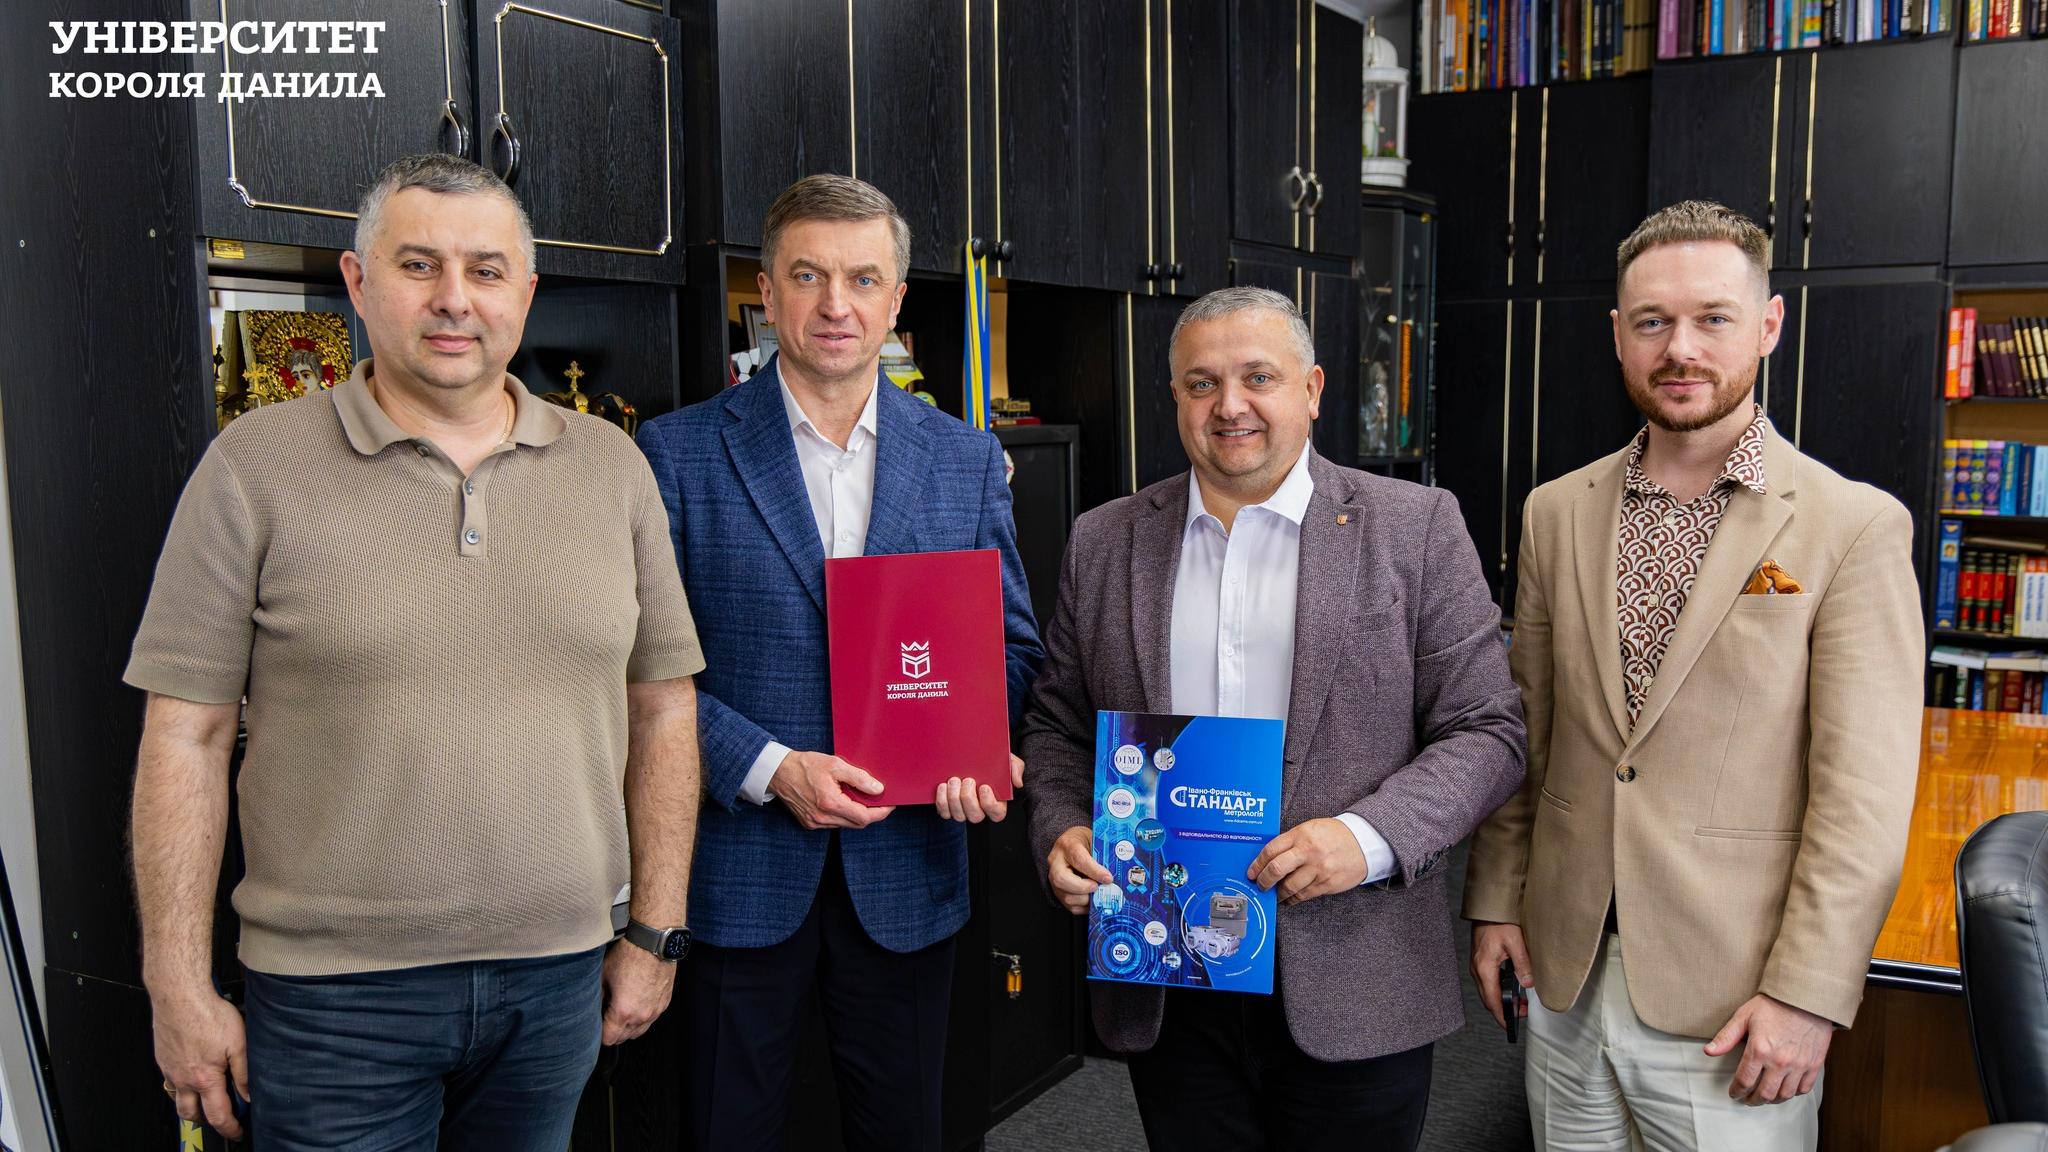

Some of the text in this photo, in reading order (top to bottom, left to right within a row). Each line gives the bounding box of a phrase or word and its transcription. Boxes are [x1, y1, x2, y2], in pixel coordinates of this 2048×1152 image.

[886, 682, 948, 691] УНІВЕРСИТЕТ
[1116, 755, 1142, 764] OIML
[1188, 787, 1252, 797] Івано-Франківськ
